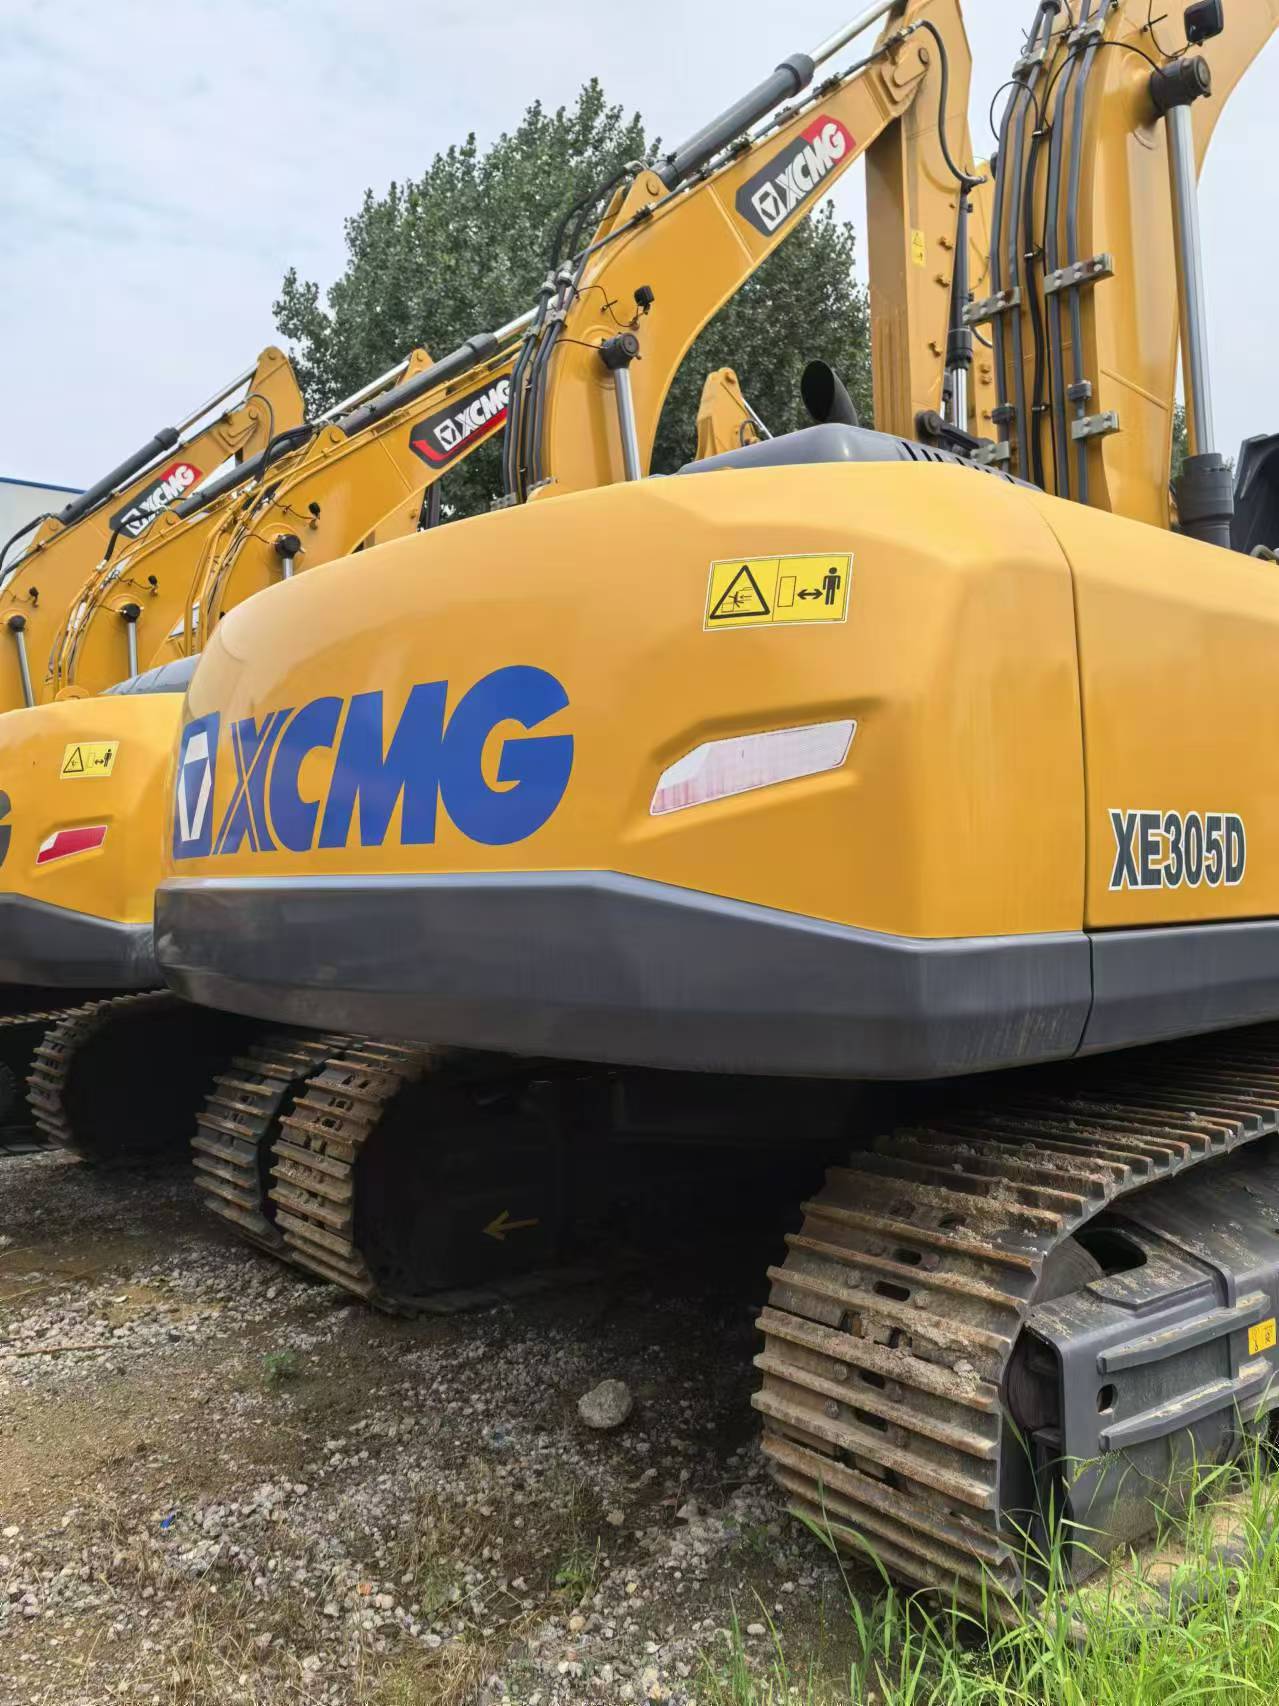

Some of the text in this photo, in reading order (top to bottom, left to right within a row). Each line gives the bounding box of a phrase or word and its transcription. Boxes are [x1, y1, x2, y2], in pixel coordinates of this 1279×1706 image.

[775, 122, 845, 213] XCMG
[454, 379, 510, 440] XCMG
[138, 465, 195, 522] XCMG
[210, 664, 574, 856] XCMG
[1108, 809, 1247, 891] XE305D
